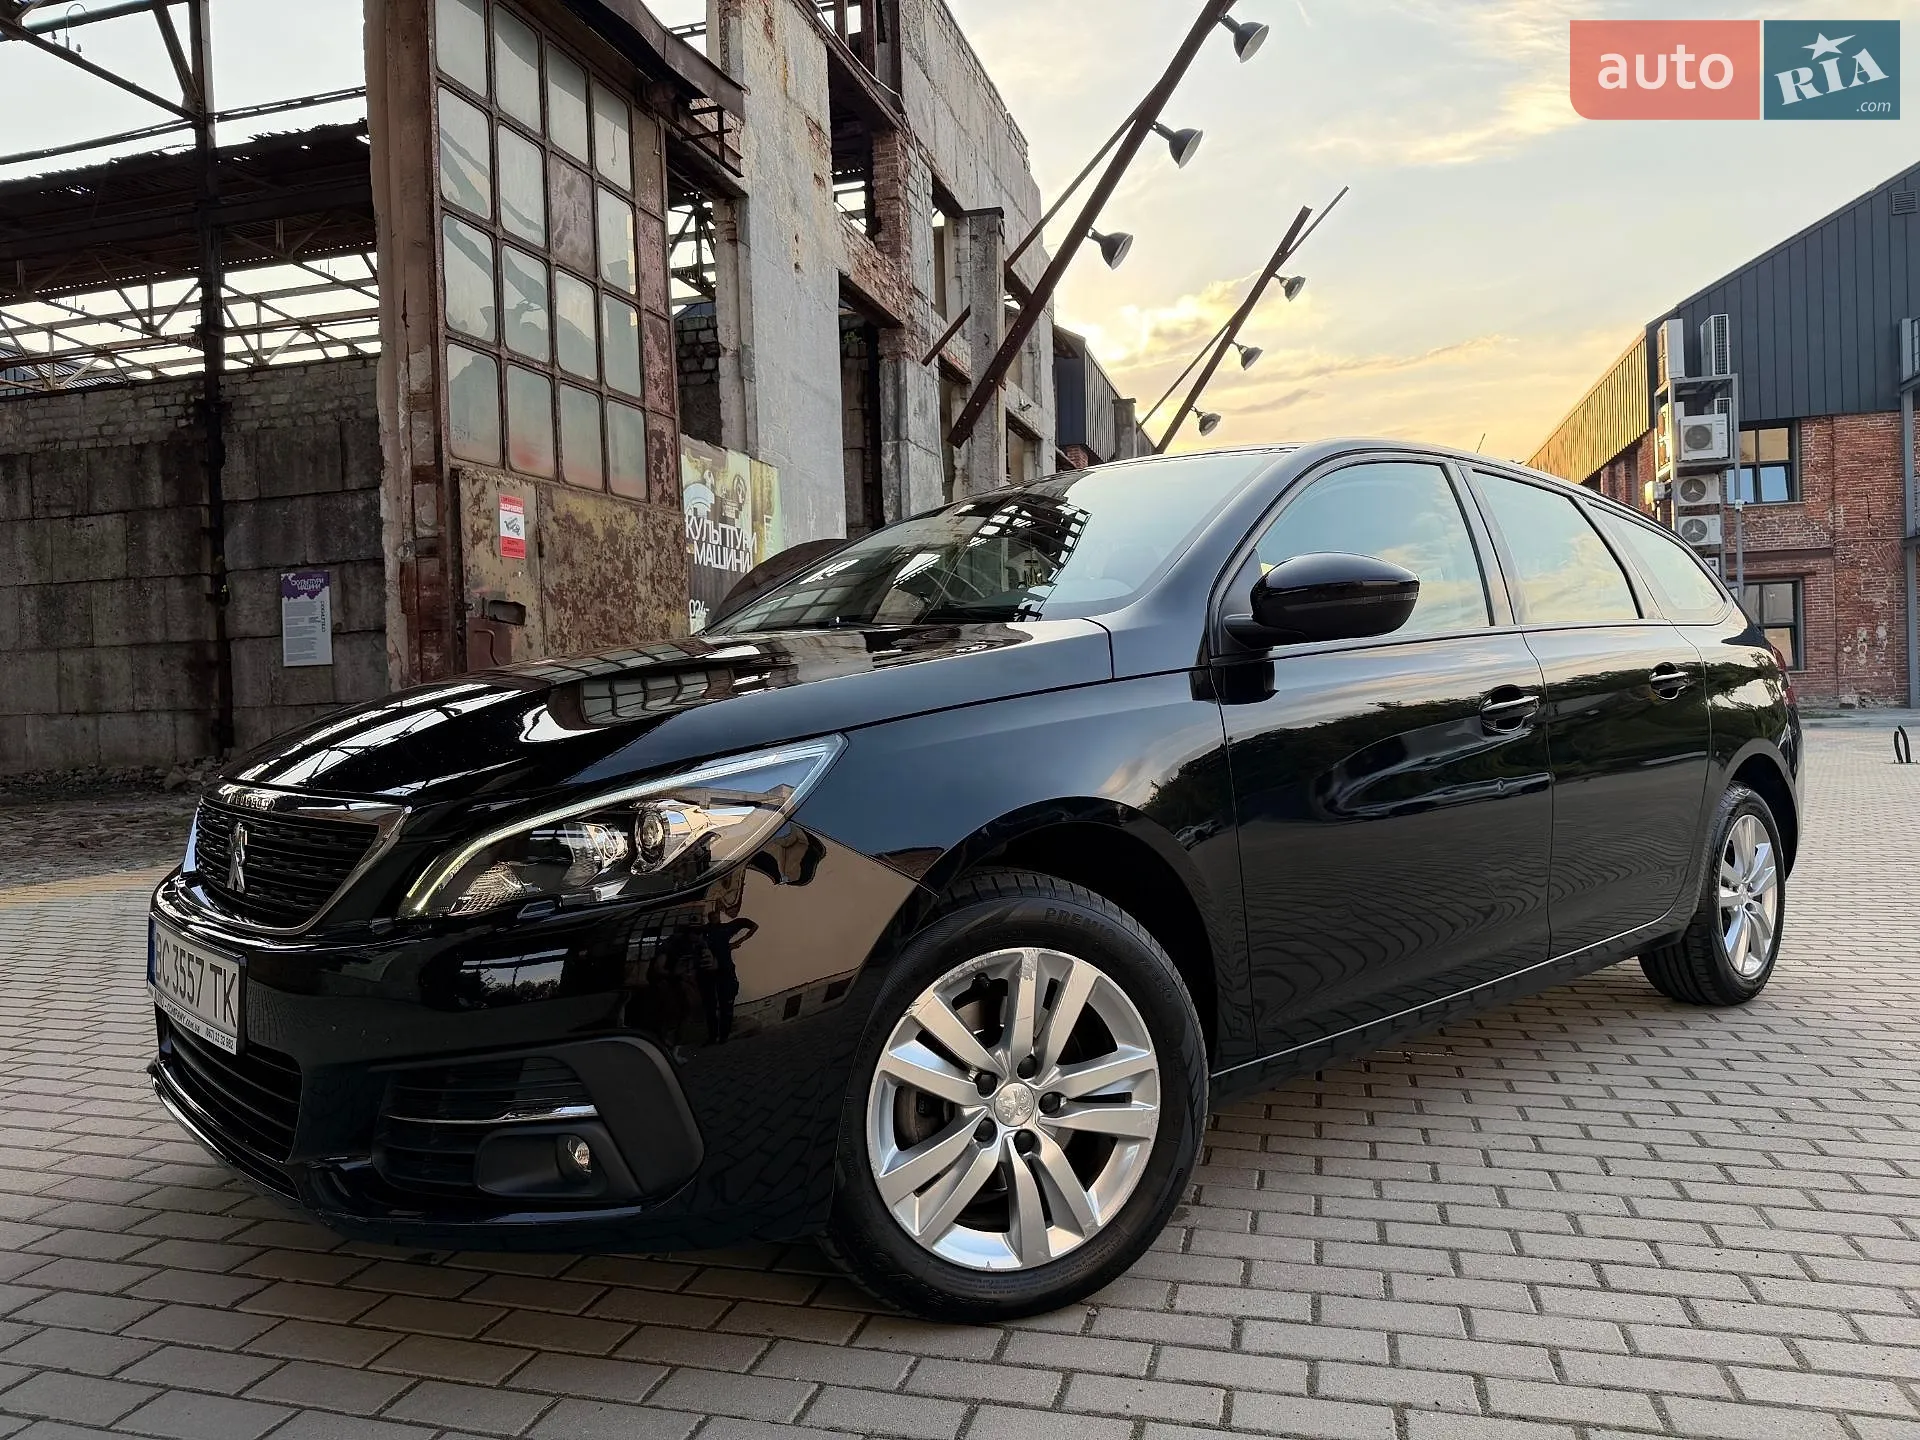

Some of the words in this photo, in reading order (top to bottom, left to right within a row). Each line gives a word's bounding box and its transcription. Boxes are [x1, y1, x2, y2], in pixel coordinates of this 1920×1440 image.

[685, 515, 758, 554] КУЛЬПТУРИ
[694, 541, 753, 573] МАШИНИ
[155, 932, 170, 988] BC
[172, 944, 204, 1008] 3557
[210, 963, 237, 1028] TK
